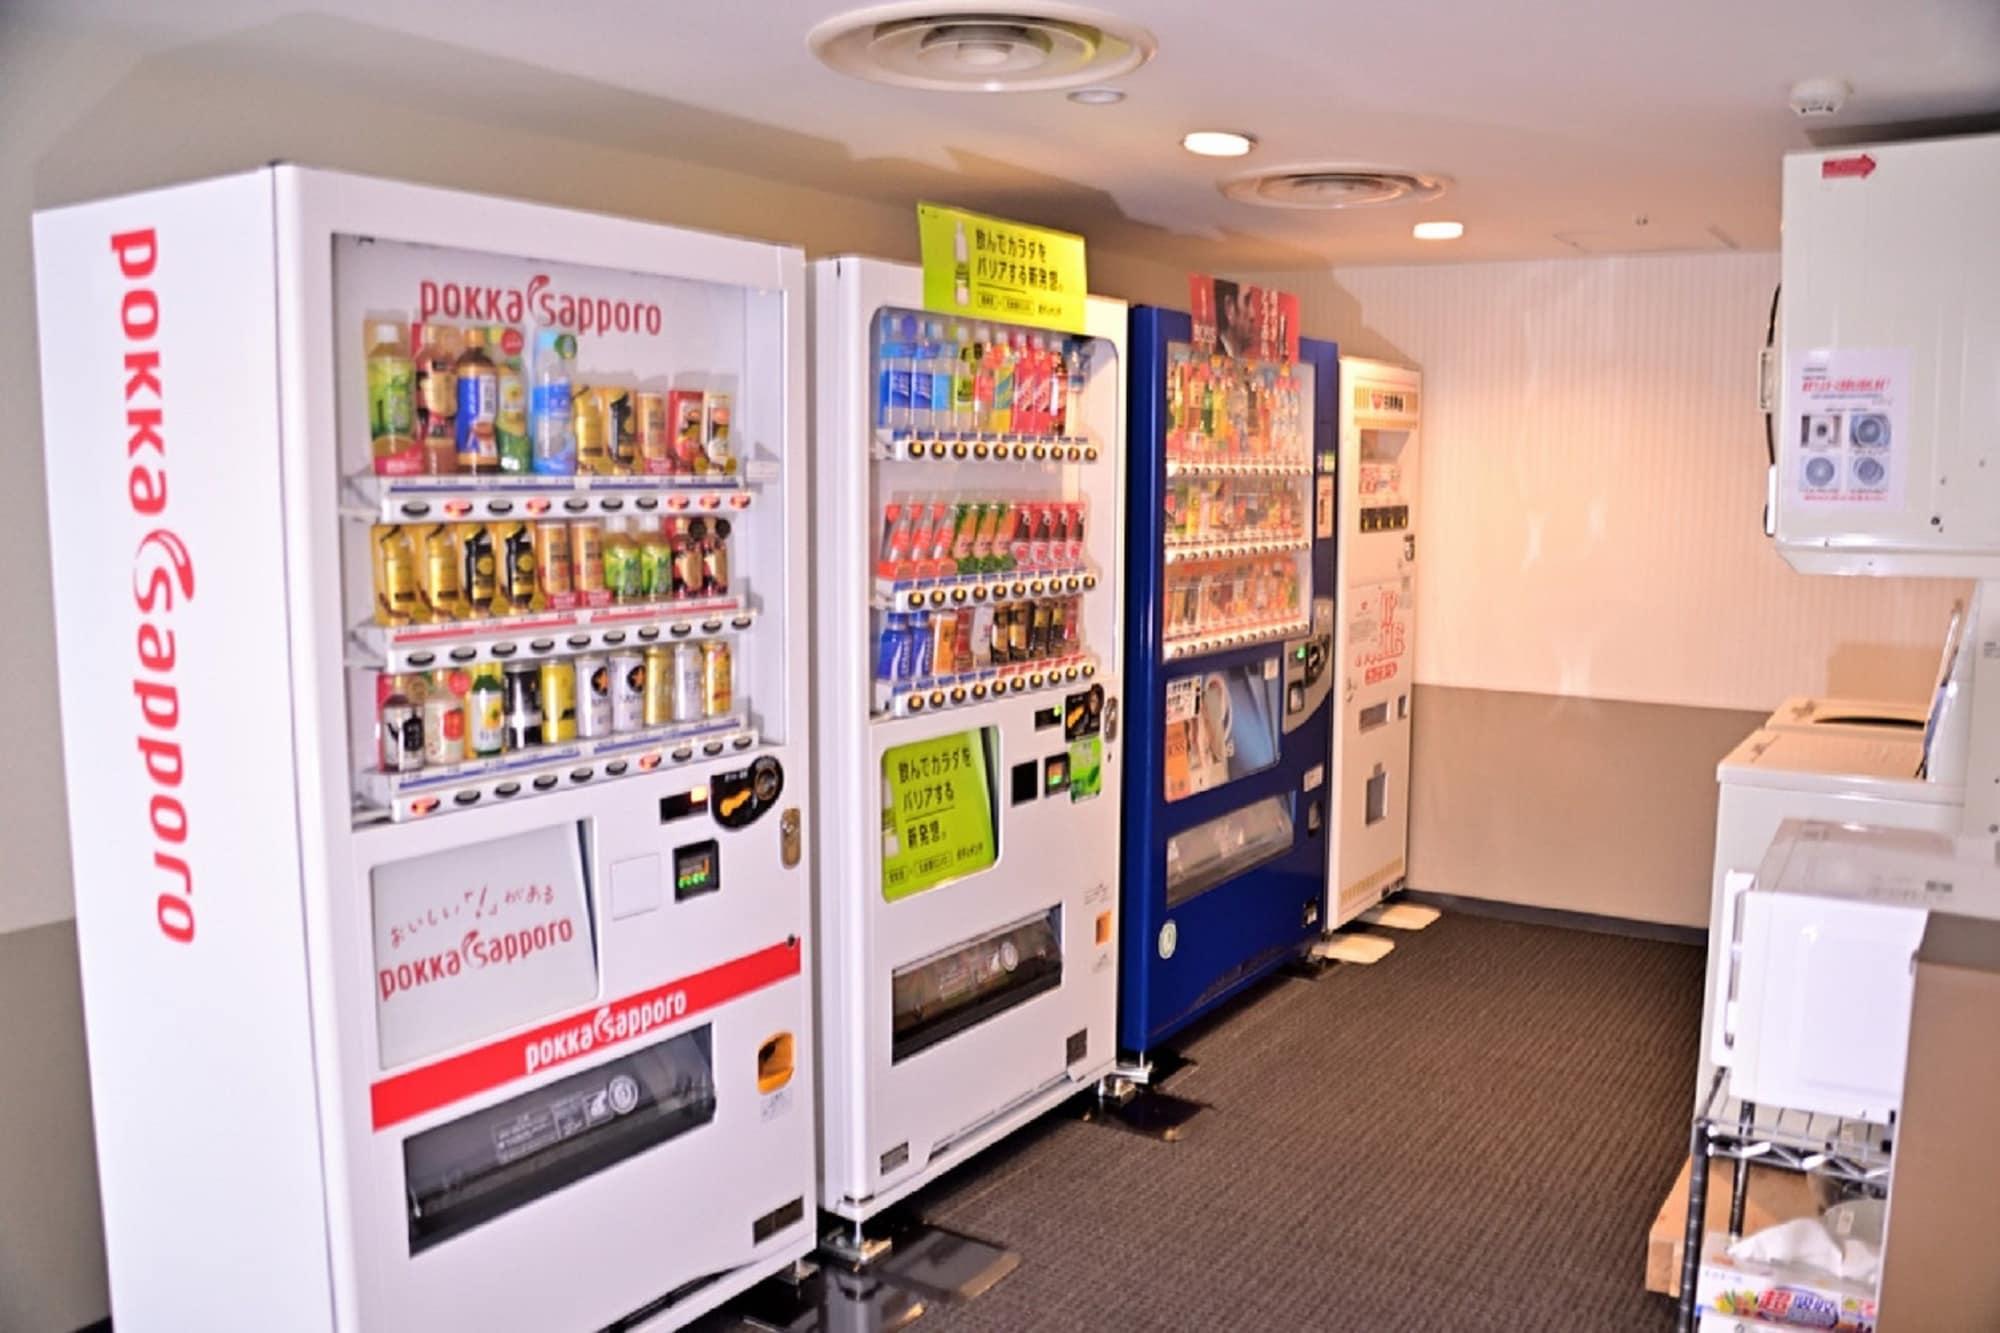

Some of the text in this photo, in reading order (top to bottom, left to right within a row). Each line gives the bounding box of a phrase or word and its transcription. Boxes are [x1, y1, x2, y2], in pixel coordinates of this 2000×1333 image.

[898, 747, 971, 784] 飲んでカラダを
[903, 781, 955, 812] バリアする
